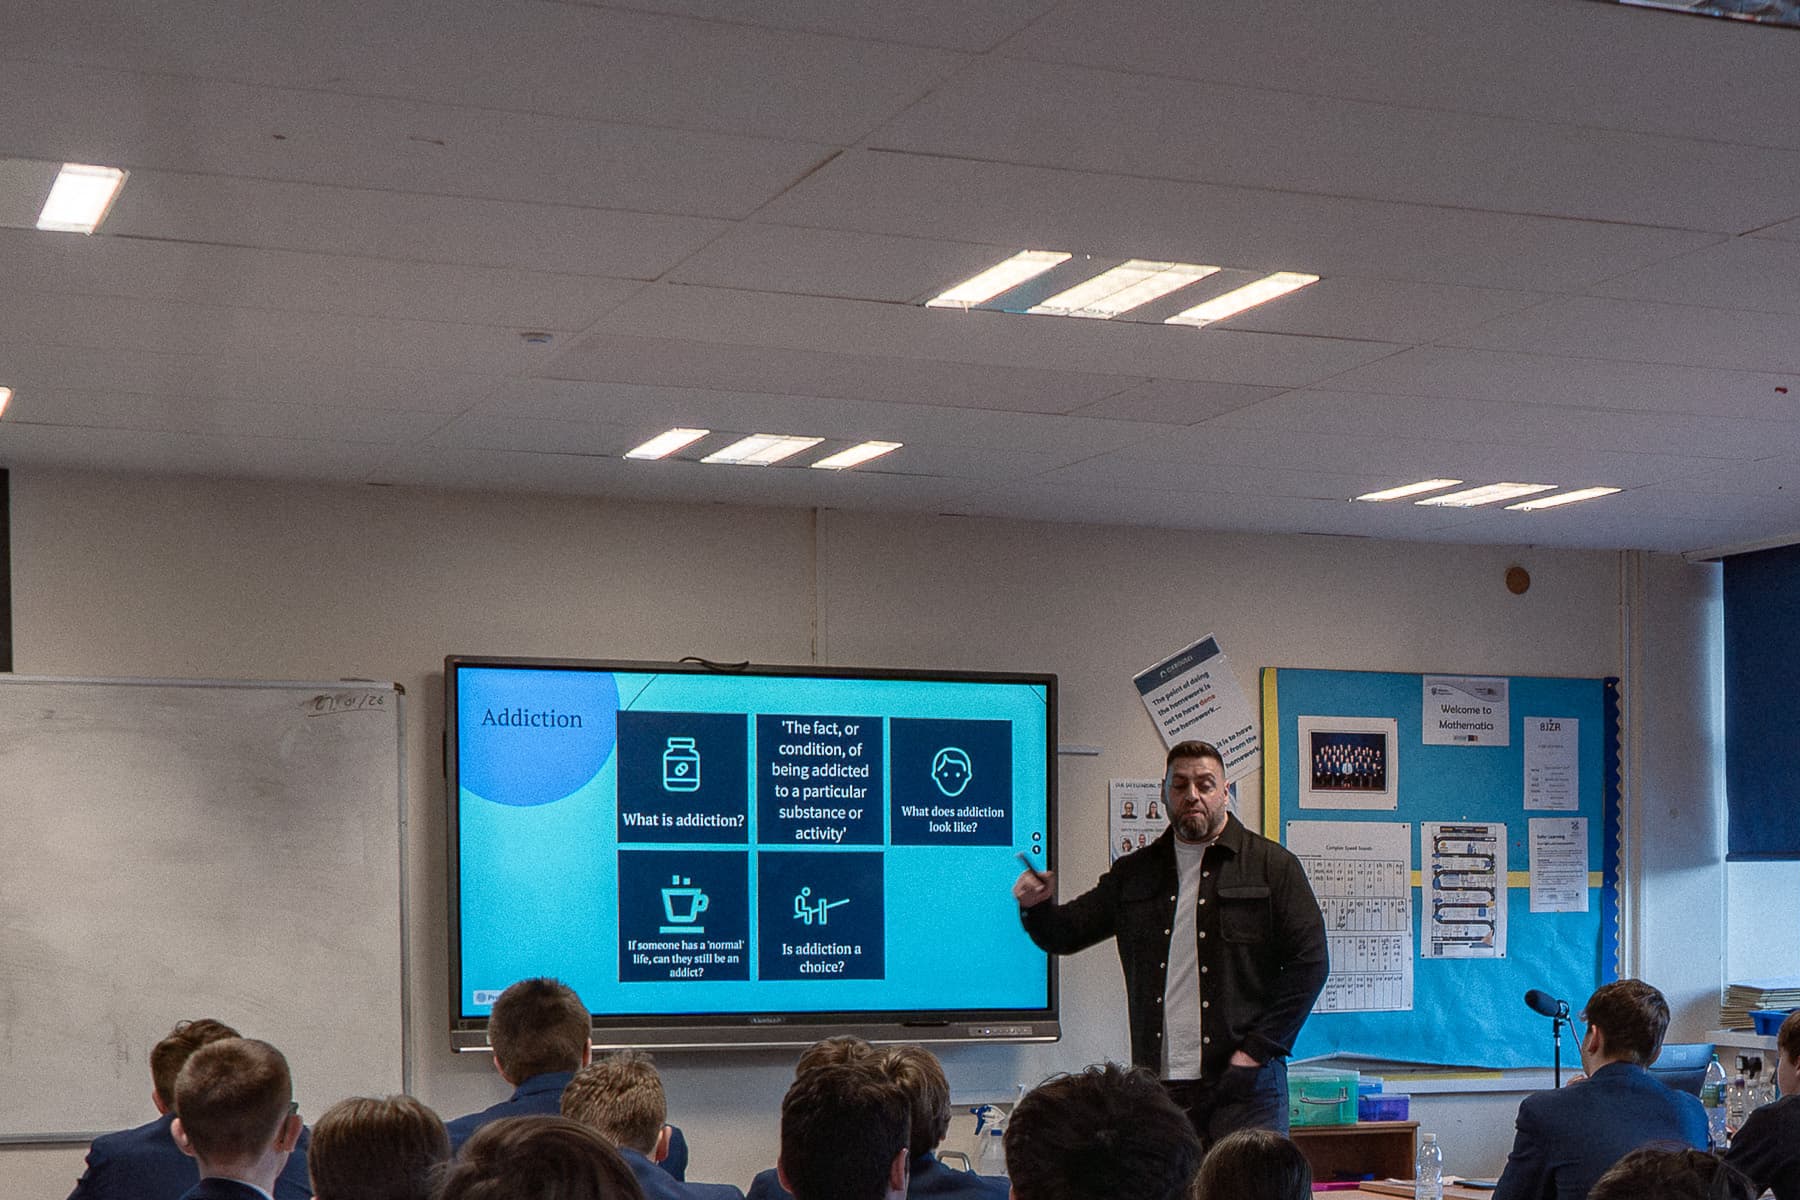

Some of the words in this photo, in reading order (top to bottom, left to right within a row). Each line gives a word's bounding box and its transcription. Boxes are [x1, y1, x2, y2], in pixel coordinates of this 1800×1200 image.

[1152, 695, 1165, 706] The
[1165, 686, 1182, 701] point
[1190, 671, 1210, 686] doing
[1157, 706, 1170, 717] the
[1169, 688, 1204, 710] homework
[1164, 716, 1175, 726] not
[1182, 703, 1200, 716] have
[1199, 694, 1216, 706] done
[1441, 704, 1481, 714] Welcome
[1482, 706, 1492, 714] to
[482, 707, 582, 728] Addiction
[1439, 719, 1494, 730] Mathematics
[782, 720, 810, 734] 'The
[814, 720, 841, 737] fact,
[845, 724, 860, 735] or
[1168, 726, 1181, 737] the
[779, 742, 846, 758] condition,
[848, 742, 863, 757] of
[772, 762, 809, 779] being
[812, 763, 869, 778] addicted
[775, 784, 789, 797] to
[792, 786, 800, 797] a
[803, 784, 867, 800] particular
[779, 804, 846, 819] substance
[848, 808, 863, 819] or
[901, 805, 929, 817] What
[931, 805, 955, 817] does
[956, 806, 1005, 818] addiction
[623, 812, 659, 826] What
[662, 812, 674, 827] is
[676, 813, 745, 827] addiction?
[929, 821, 951, 832] look
[953, 821, 977, 832] like?
[795, 827, 847, 843] activity'
[628, 940, 637, 951] If
[638, 941, 680, 951] someone
[681, 940, 698, 950] has
[700, 941, 706, 950] a
[707, 940, 745, 950] 'normal'
[782, 943, 792, 955] Is
[795, 942, 852, 955] addiction
[854, 945, 862, 955] a
[633, 953, 652, 965] life,
[653, 955, 670, 964] can
[671, 953, 692, 966] they
[694, 953, 712, 964] still
[714, 953, 726, 964] be
[727, 955, 739, 964] an
[799, 961, 845, 973] choice?
[669, 967, 704, 978] addict?
